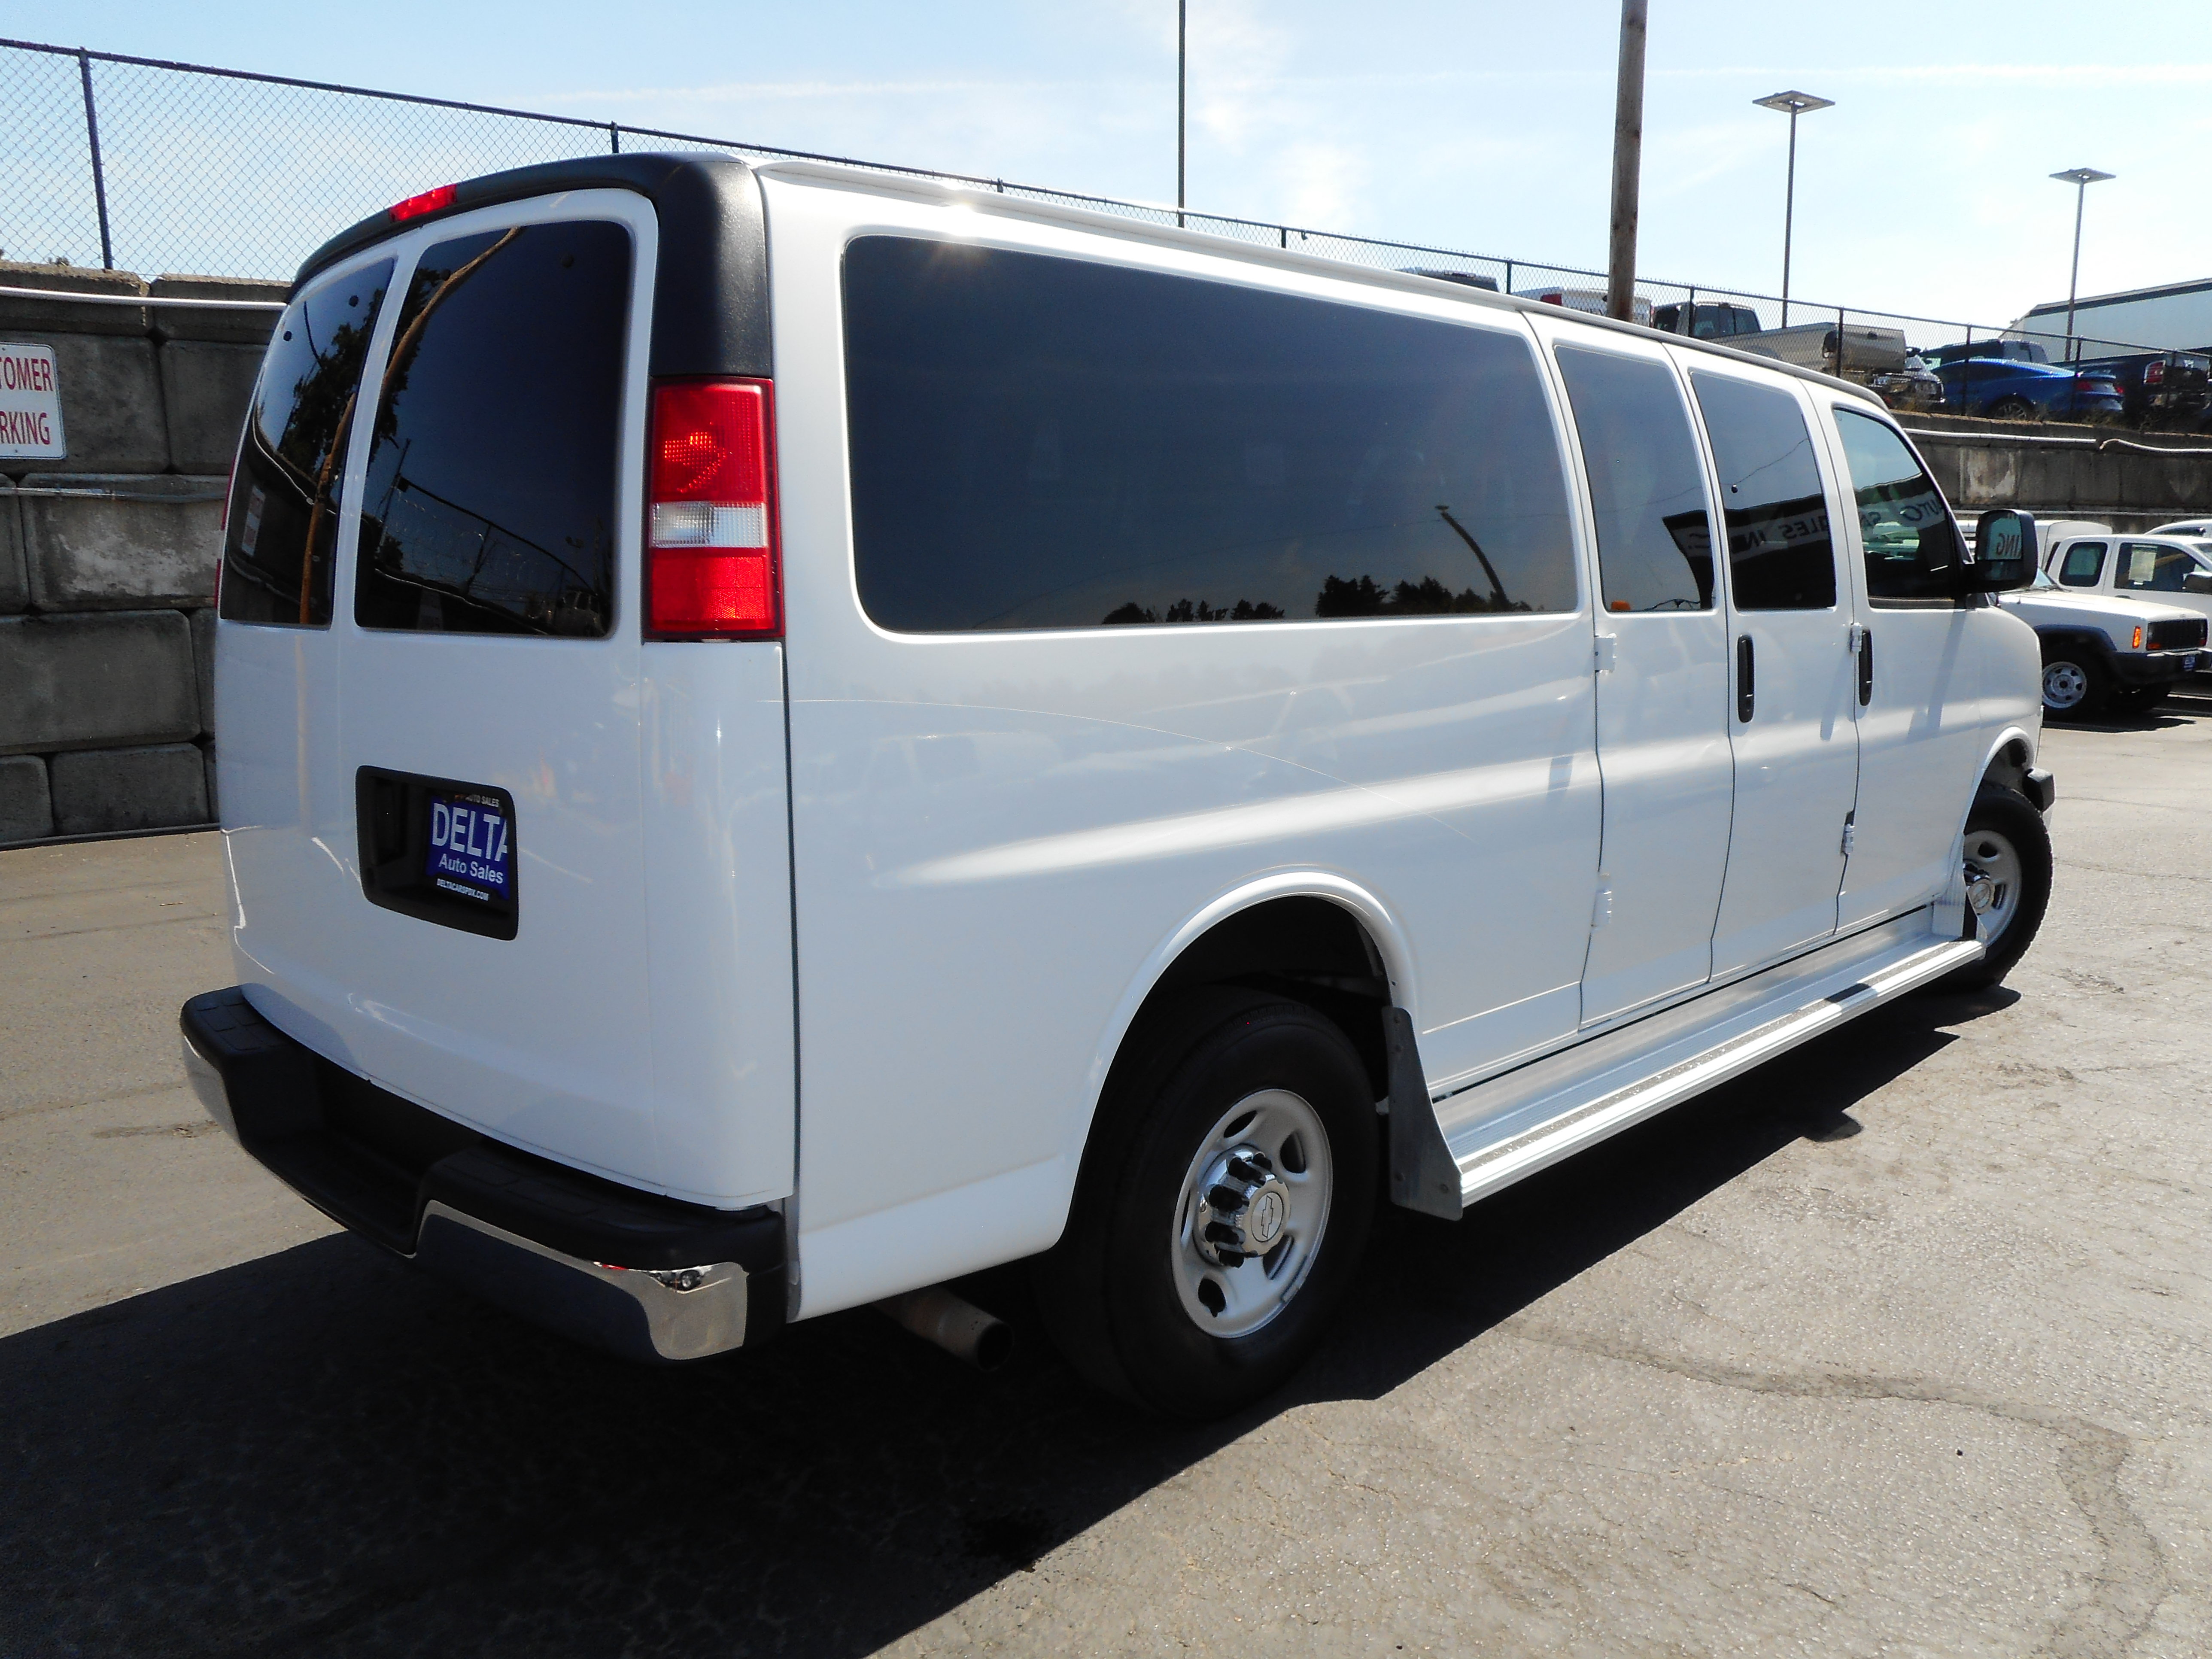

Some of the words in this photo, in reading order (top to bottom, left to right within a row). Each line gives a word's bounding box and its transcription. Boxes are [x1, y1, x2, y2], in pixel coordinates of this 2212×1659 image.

[481, 796, 499, 807] SALES
[438, 853, 467, 874] Auto
[469, 861, 504, 884] Sales
